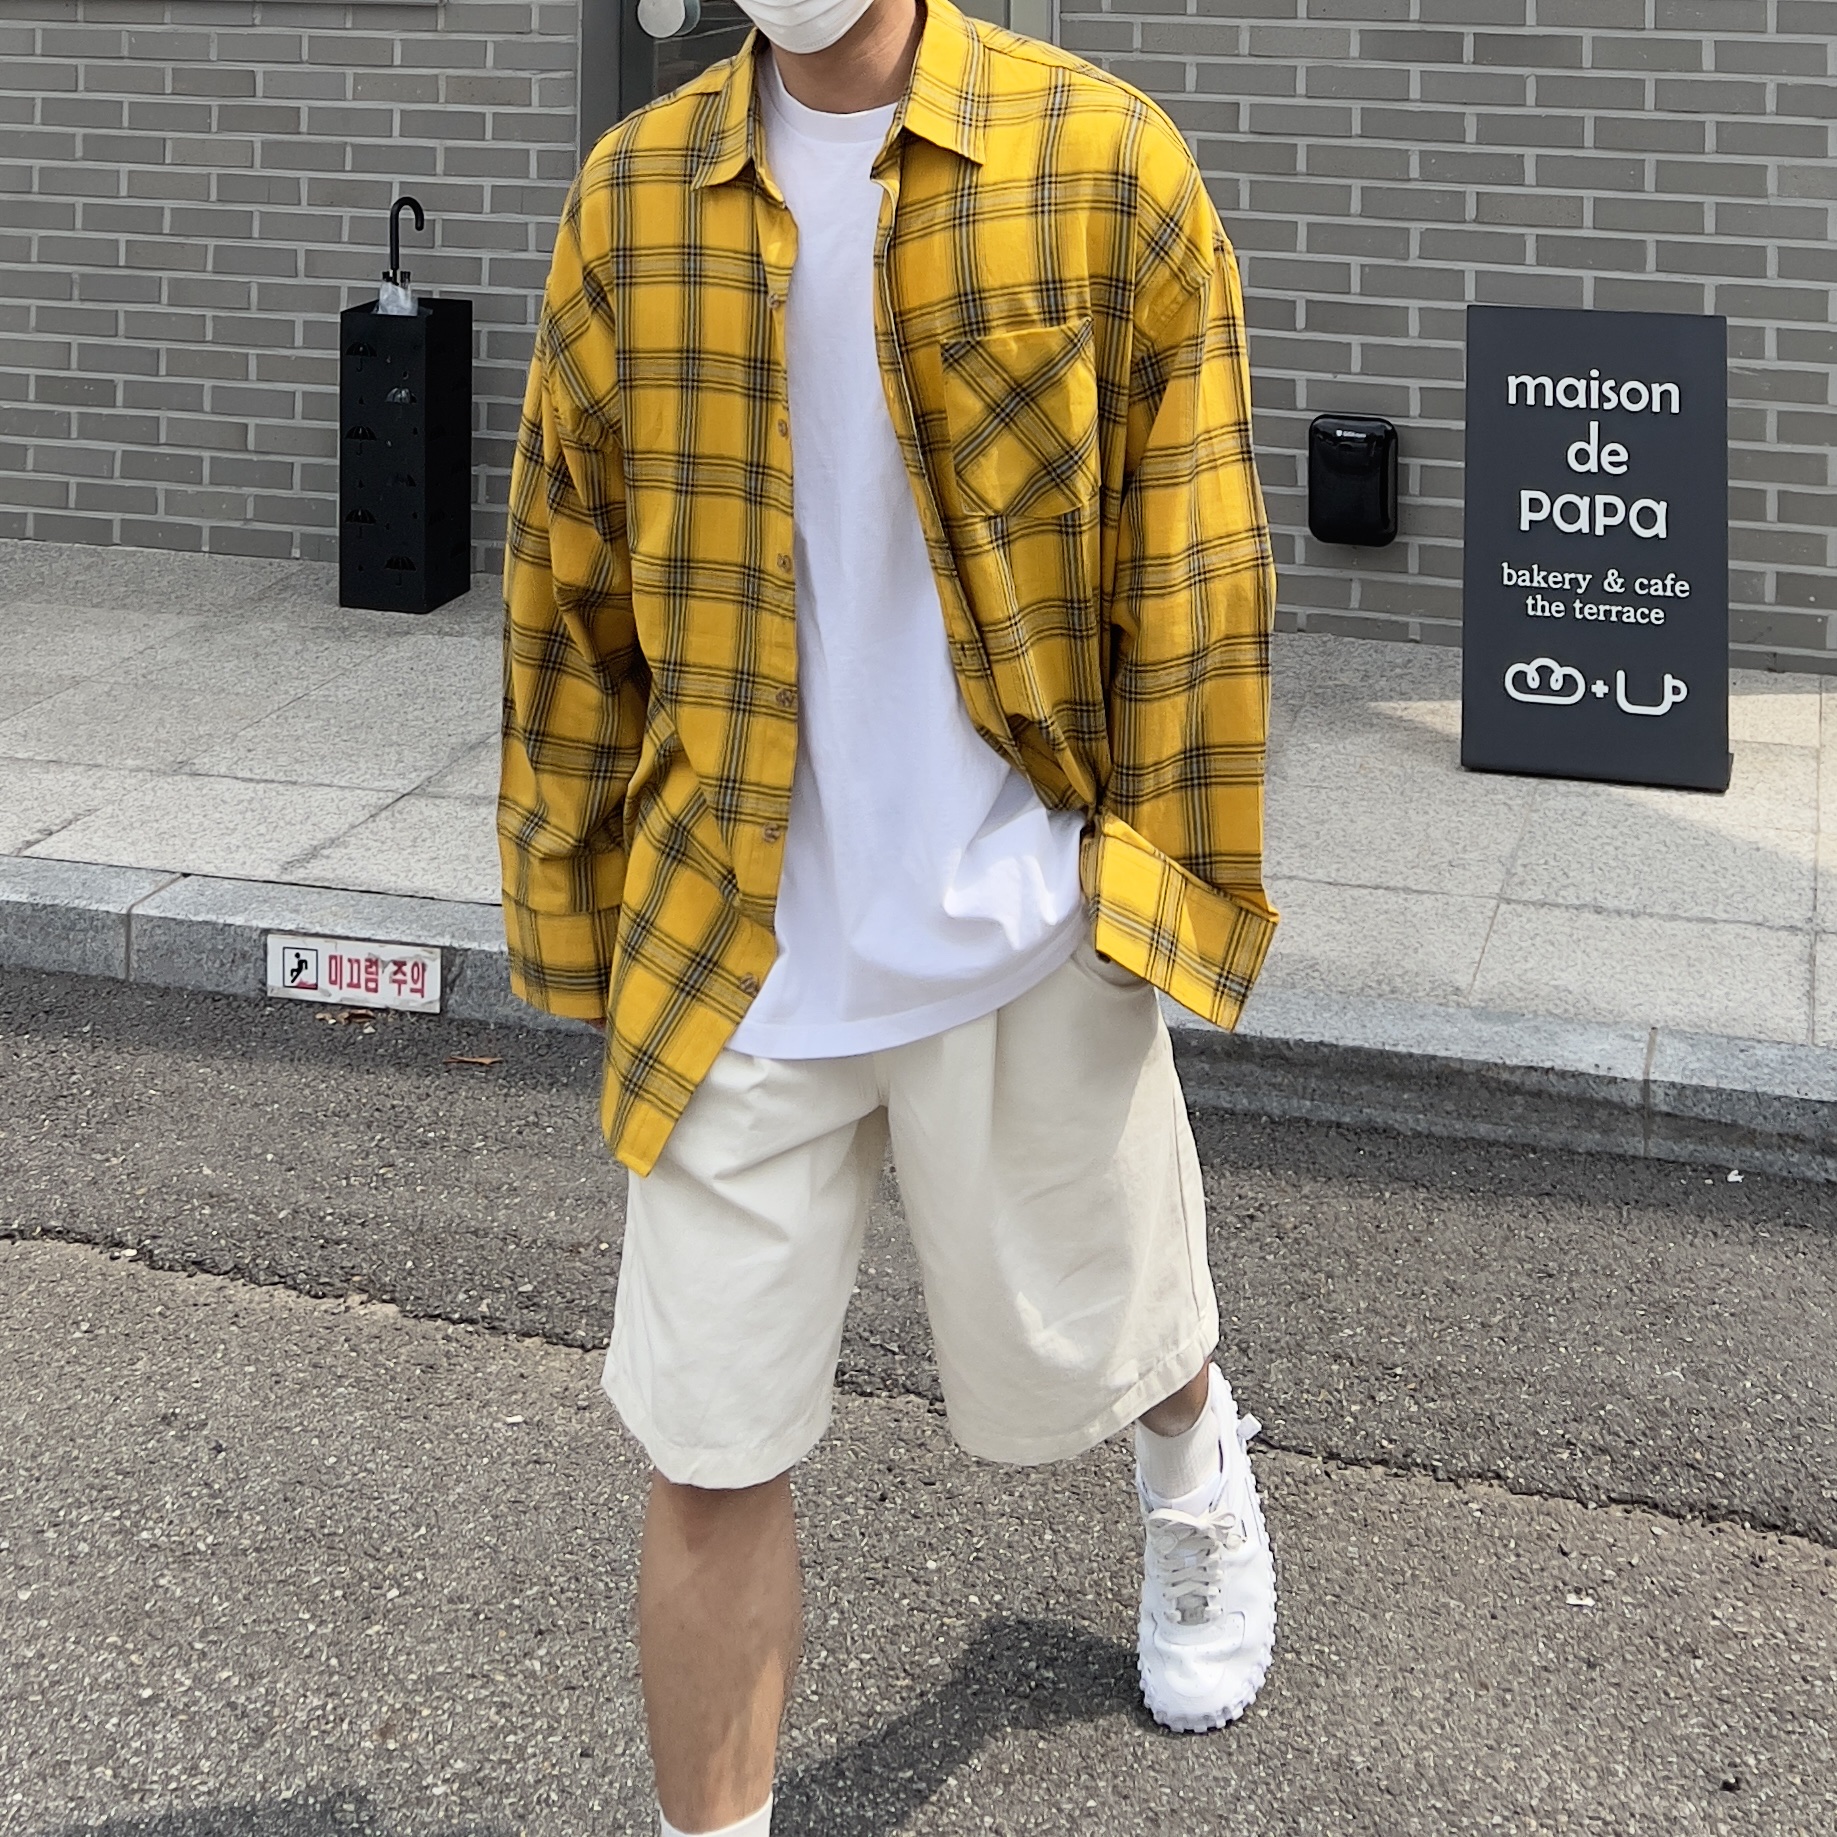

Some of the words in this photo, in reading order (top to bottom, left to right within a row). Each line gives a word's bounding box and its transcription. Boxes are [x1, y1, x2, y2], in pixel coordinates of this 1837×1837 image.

[1507, 368, 1680, 414] maison
[1567, 420, 1629, 475] de
[1501, 562, 1593, 594] bakery
[1603, 568, 1626, 593] &
[1634, 572, 1690, 598] cafe
[1525, 594, 1566, 618] the
[1572, 598, 1665, 625] terrace
[328, 954, 379, 994] 미끄럼
[391, 959, 426, 998] 주의
